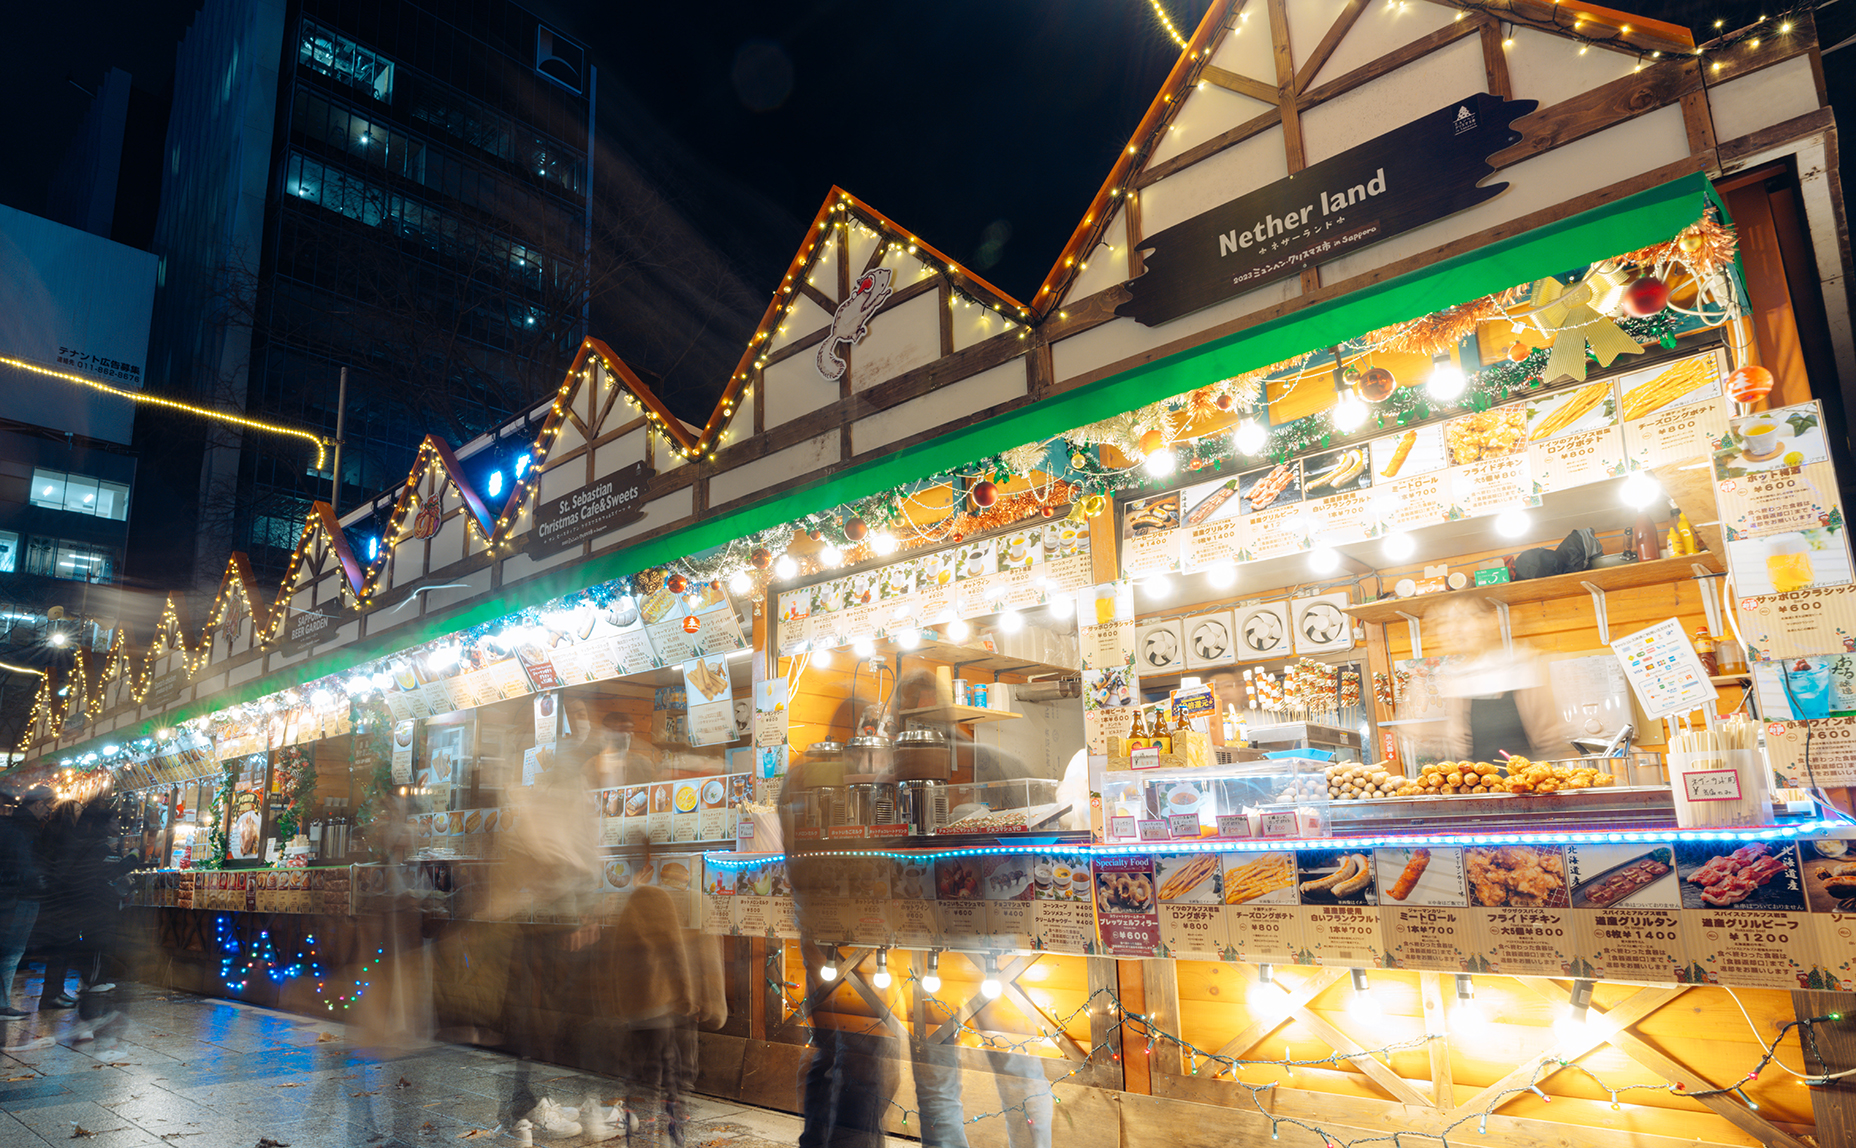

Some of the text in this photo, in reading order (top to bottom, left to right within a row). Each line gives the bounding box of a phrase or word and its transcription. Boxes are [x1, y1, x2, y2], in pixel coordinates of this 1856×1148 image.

[1218, 167, 1387, 258] Nether land
[1271, 220, 1333, 251] ネザーランド
[1333, 239, 1341, 247] in
[1342, 226, 1377, 244] Sapporo
[59, 346, 140, 375] テナント広告募集
[77, 361, 140, 383] 011-862-8676
[1638, 405, 1716, 430] チーズロングポテト
[1658, 420, 1696, 435] ¥800
[1539, 428, 1611, 449] ドイツのアルプス岩塩
[1547, 436, 1604, 453] ロングポテト
[1561, 447, 1595, 460] ¥800
[1463, 459, 1523, 477] フライドチキン
[1747, 465, 1802, 483] ホット梅酒
[1392, 476, 1439, 493] ミートロール
[1754, 479, 1796, 493] ¥600
[559, 481, 613, 515] St. Sebastian
[1400, 487, 1437, 500] 本¥700
[1312, 495, 1372, 513] 白いフランクフルト
[1747, 501, 1811, 516] 食べ終わった食器は
[538, 511, 579, 538] Christmas
[580, 486, 639, 520] Cafe&Sweets
[1250, 508, 1300, 525] 道産グリルビーフ
[1130, 529, 1174, 543] ソーセージセット
[1192, 522, 1236, 538] 道産グリルタン
[1139, 538, 1167, 548] ¥1400
[1051, 559, 1073, 568] コーンスープ
[963, 579, 990, 589] ホットワイン
[1756, 584, 1856, 604] サッポロクラシック
[1778, 601, 1822, 613] ¥600
[297, 608, 323, 627] SAPPORO
[291, 616, 329, 640] BEER GARDEN
[1088, 619, 1134, 632] サッポロクラシック
[1097, 630, 1118, 638] ¥600
[1831, 654, 1854, 680] おたる
[1805, 730, 1851, 739] ¥600
[1096, 858, 1149, 868] Specialty Food
[1782, 845, 1800, 891] 北海道産
[1165, 905, 1220, 913] ドイツのアルプス岩塩
[1172, 912, 1214, 920] ロングポテト
[1236, 912, 1294, 920] チーズロングポテト
[1310, 914, 1380, 923] 白いフランクフルト
[1400, 912, 1456, 922] ミートロール
[1487, 914, 1561, 923] フライドチキン
[1595, 916, 1678, 927] 道産グリルタン
[1183, 922, 1208, 930] ¥800
[1251, 923, 1280, 932] ¥800
[1329, 926, 1372, 934] 1本¥700
[1407, 925, 1454, 934] 1本¥700
[1701, 917, 1799, 930] 道産グリルビーフ
[1119, 931, 1149, 940] ¥600
[1501, 926, 1564, 936] 大5個¥800
[1605, 930, 1676, 940] 6枚¥1400
[1729, 932, 1789, 943] ¥1200
[1603, 947, 1666, 956] 食べ終わった食器は
[1717, 950, 1788, 959] 食べ終わった食器は
[1719, 966, 1790, 975] 返却をお願いします
